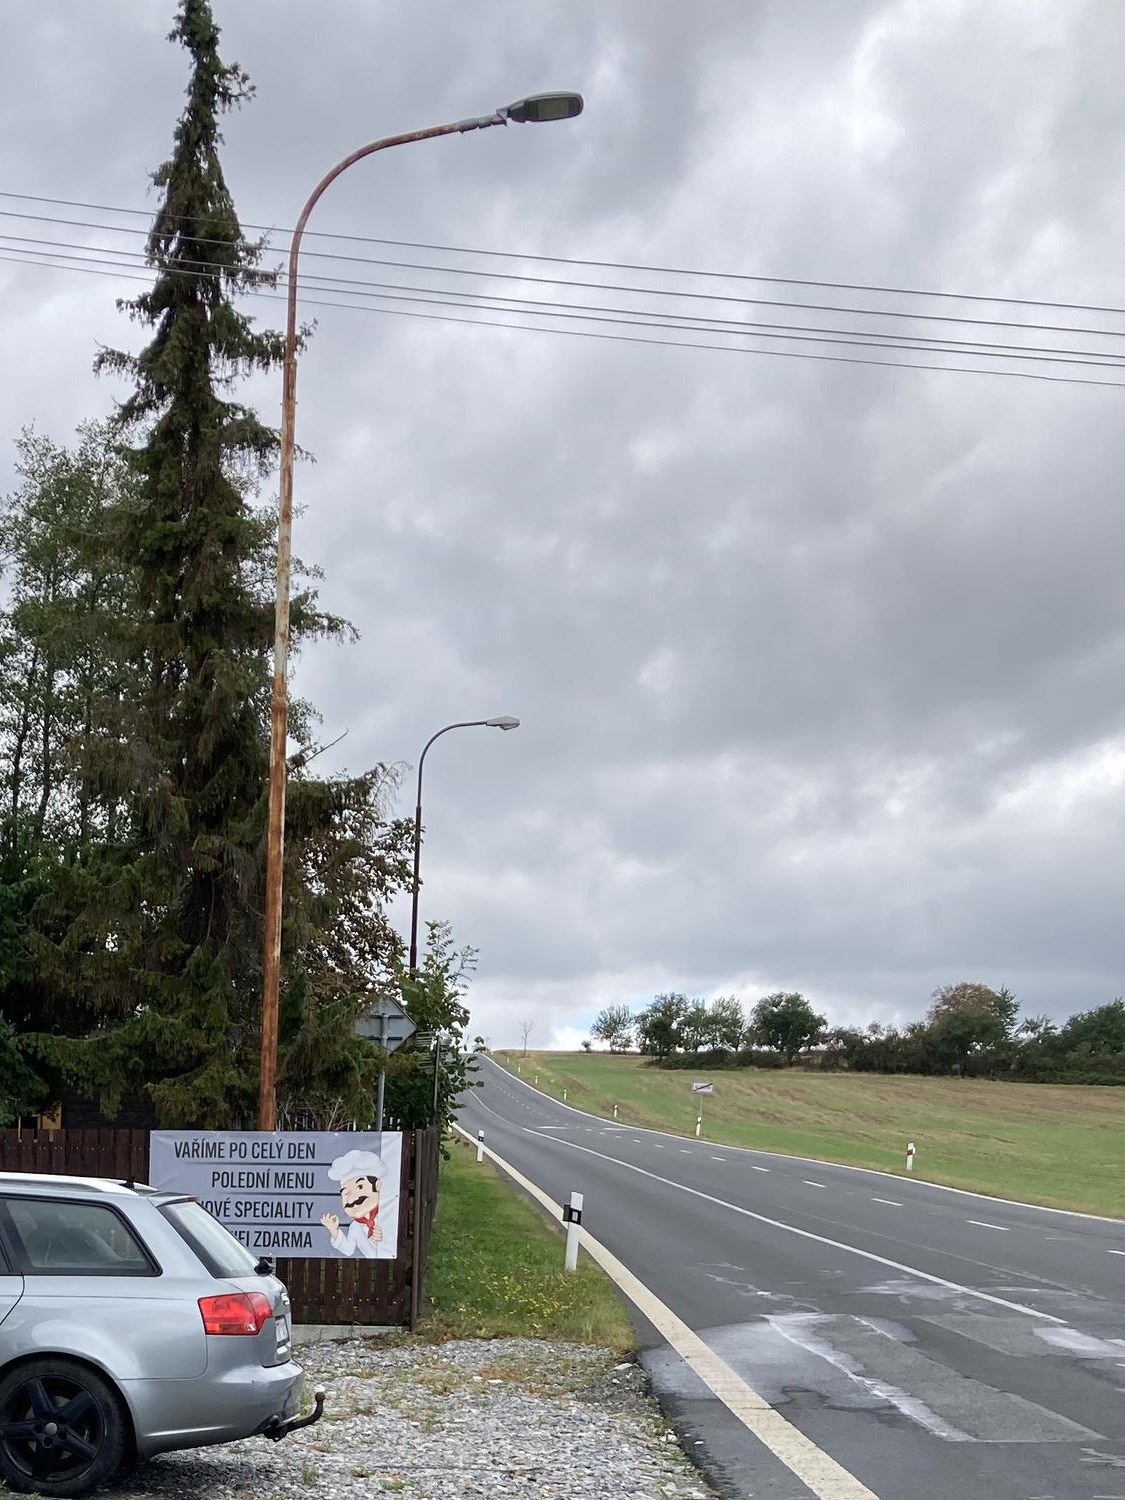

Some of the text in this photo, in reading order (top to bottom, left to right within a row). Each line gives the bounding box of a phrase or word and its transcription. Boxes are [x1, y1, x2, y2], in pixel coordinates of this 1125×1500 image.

[174, 1138, 316, 1160] VAŘÍME PO CELÝ DEN
[211, 1168, 315, 1190] POLEDNÍ MENU
[201, 1197, 314, 1219] OVÉ SPECIALITY
[253, 1230, 313, 1249] ZDARMA
